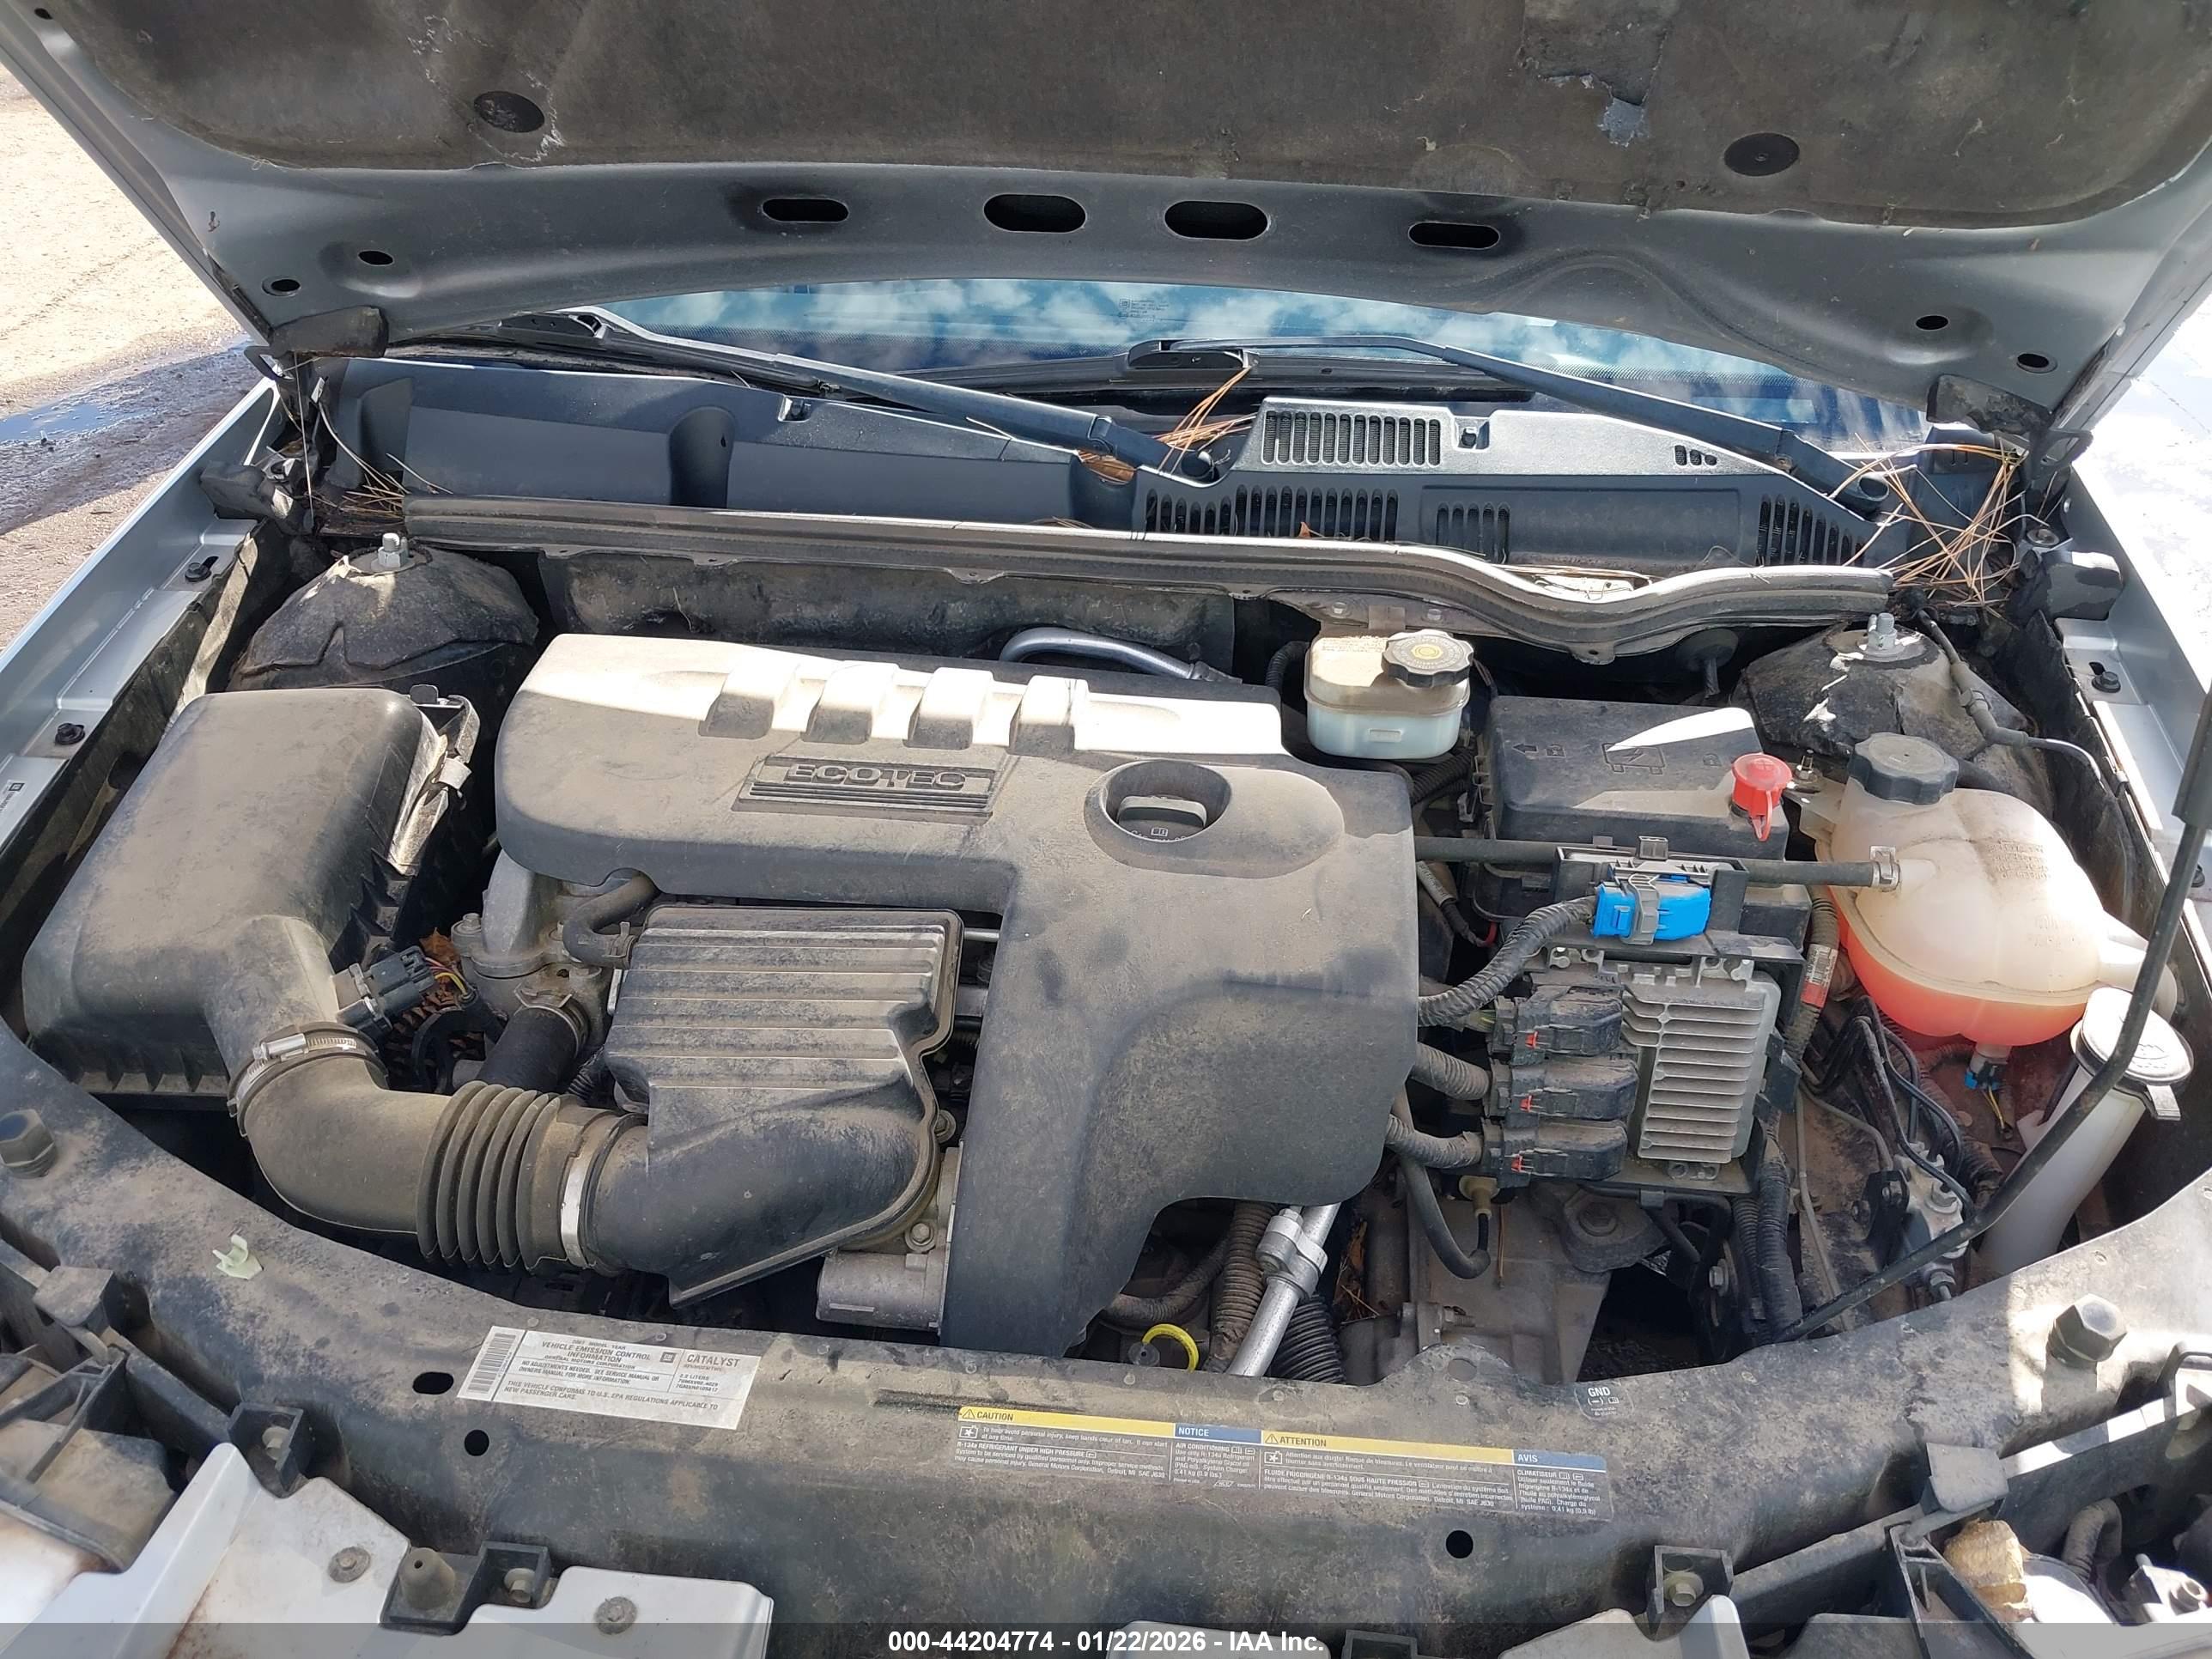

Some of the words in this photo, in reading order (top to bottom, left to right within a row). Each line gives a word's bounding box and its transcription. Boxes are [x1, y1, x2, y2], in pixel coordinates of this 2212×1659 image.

[784, 763, 966, 790] ECOTEC
[540, 1341, 574, 1351] VEHICLE
[575, 1346, 612, 1356] EMISSION
[615, 1350, 651, 1360] CONTROL
[567, 1352, 621, 1363] INFORMATION
[687, 1354, 739, 1367] CATALYST
[530, 1362, 568, 1370] ADJUSTMENTS
[596, 1361, 635, 1370] CORPORATION
[520, 1389, 556, 1398] PASSENGER
[1588, 1386, 1610, 1397] GND
[550, 1386, 585, 1395] CONFORMS
[625, 1395, 668, 1404] REGULATIONS
[670, 1400, 707, 1408] APPLICABLE
[976, 1411, 1013, 1420] CAUTION
[1178, 1426, 1209, 1437] NOTICE
[1279, 1436, 1326, 1446] ATTENTION
[978, 1443, 1018, 1451] REFRIGERANT
[1187, 1443, 1230, 1452] CONDITIONING
[1517, 1454, 1538, 1462] AVIS
[1516, 1469, 1556, 1478] CLIMATISEUR
